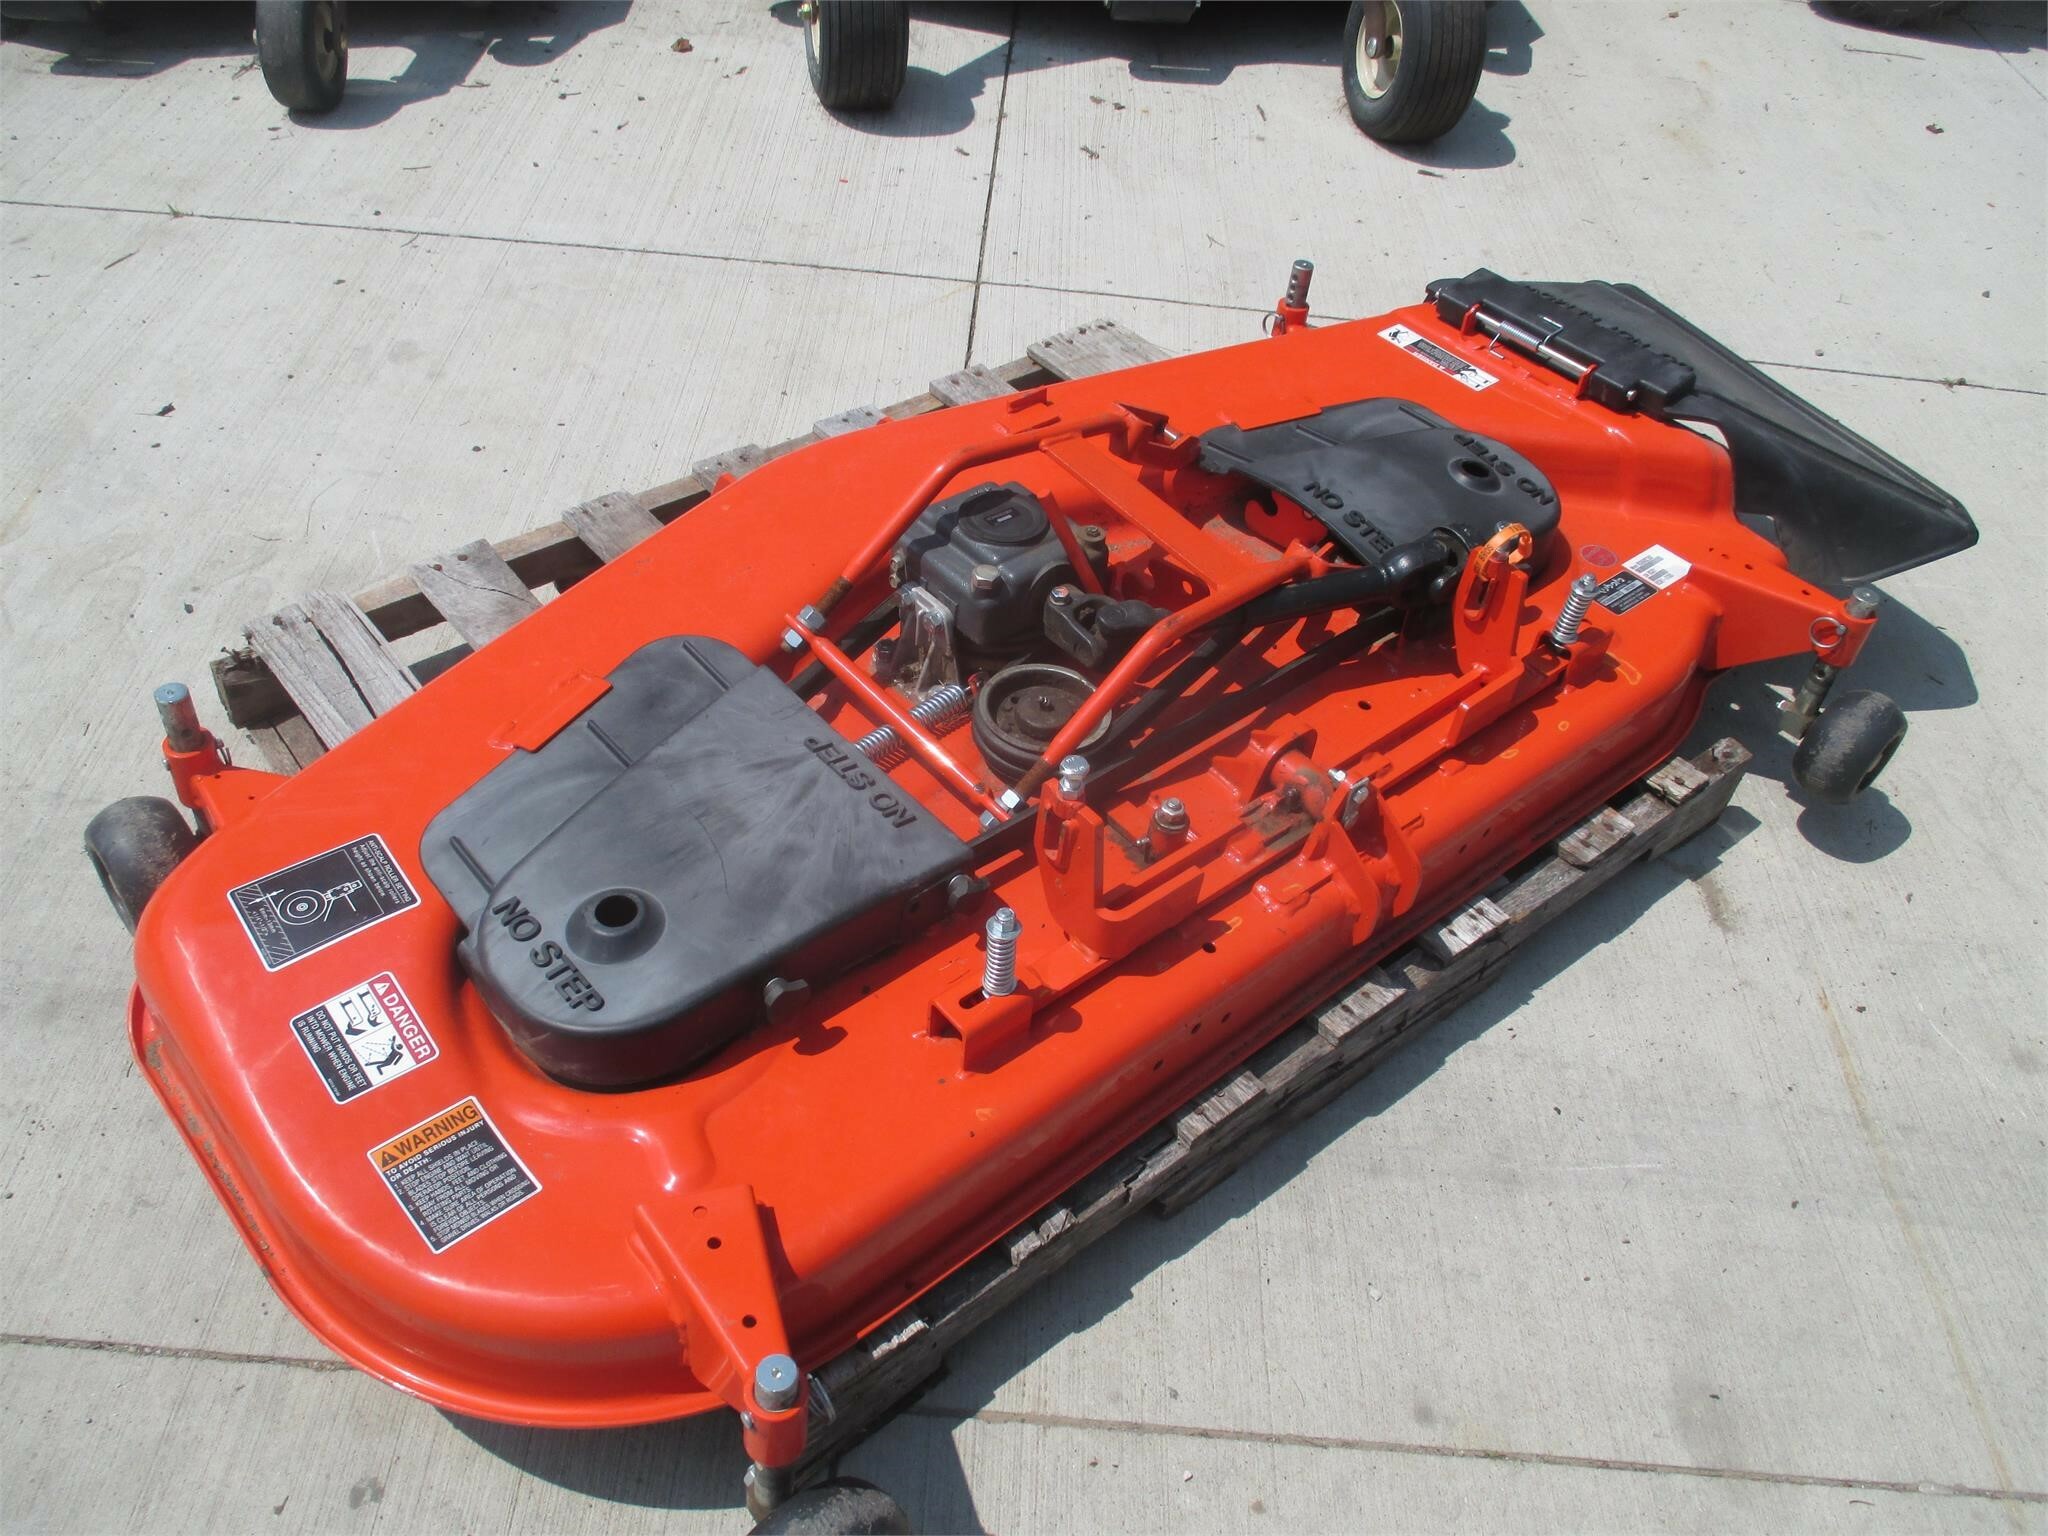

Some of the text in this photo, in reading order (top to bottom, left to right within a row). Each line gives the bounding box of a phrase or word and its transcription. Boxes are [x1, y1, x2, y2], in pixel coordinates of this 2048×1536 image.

[1453, 433, 1554, 506] NO STEP
[1303, 481, 1395, 555] NO STE
[803, 735, 919, 829] NO STEP
[349, 846, 364, 862] height
[363, 867, 378, 883] shown
[358, 843, 372, 858] Adjust
[367, 857, 377, 866] the
[386, 887, 401, 904] rollers
[367, 839, 412, 902] ANTI-SCALP ROLLER SETTING
[491, 895, 606, 1013] NO STEP
[296, 1019, 322, 1053] IS RUNNING
[314, 1009, 367, 1087] DO NOT PUT HANDS OR FEET
[381, 992, 432, 1059] DANGER
[305, 1014, 320, 1030] INTO
[313, 1028, 333, 1052] MOWER
[326, 1050, 344, 1070] WHEN
[337, 1067, 357, 1091] ENGINE
[392, 1103, 478, 1158] WARNING
[397, 1153, 423, 1170] AVOID
[422, 1133, 457, 1156] SERIOUS
[456, 1118, 485, 1138] INJURY
[399, 1173, 417, 1186] KEEP
[415, 1166, 428, 1177] ALL
[427, 1152, 453, 1171] SHIELDS
[402, 1155, 432, 1175] DEATH:
[403, 1178, 421, 1191] STOP
[419, 1166, 443, 1182] ENGINE
[441, 1158, 456, 1170] AND
[454, 1150, 471, 1162] WAIT
[470, 1141, 489, 1154] UNTIL
[407, 1144, 495, 1196] BLADES STOP BEFORE LEAVING
[411, 1180, 443, 1202] OPERATOR
[414, 1194, 430, 1206] KEEP
[465, 1166, 480, 1178] AND
[478, 1151, 508, 1171] CLOTHING
[418, 1198, 436, 1212] AWAY
[435, 1188, 454, 1202] FROM
[452, 1181, 466, 1192] ALL
[464, 1168, 490, 1186] MOVING
[421, 1196, 452, 1217] ROTATING
[425, 1208, 444, 1222] MAKE
[442, 1199, 460, 1212] SURE
[459, 1190, 477, 1203] AREA
[483, 1166, 517, 1189] OPERATION
[435, 1208, 457, 1224] CLEAR
[463, 1196, 477, 1207] ALL
[475, 1180, 504, 1200] PERSONS
[502, 1172, 517, 1184] AND
[436, 1226, 452, 1238] STOP
[450, 1213, 472, 1230] MOWER
[469, 1202, 490, 1218] BLADES
[489, 1193, 506, 1206] WHEN
[504, 1178, 531, 1197] CROSSING
[432, 1214, 460, 1233] FOREIGN
[440, 1227, 461, 1243] GRAVEL
